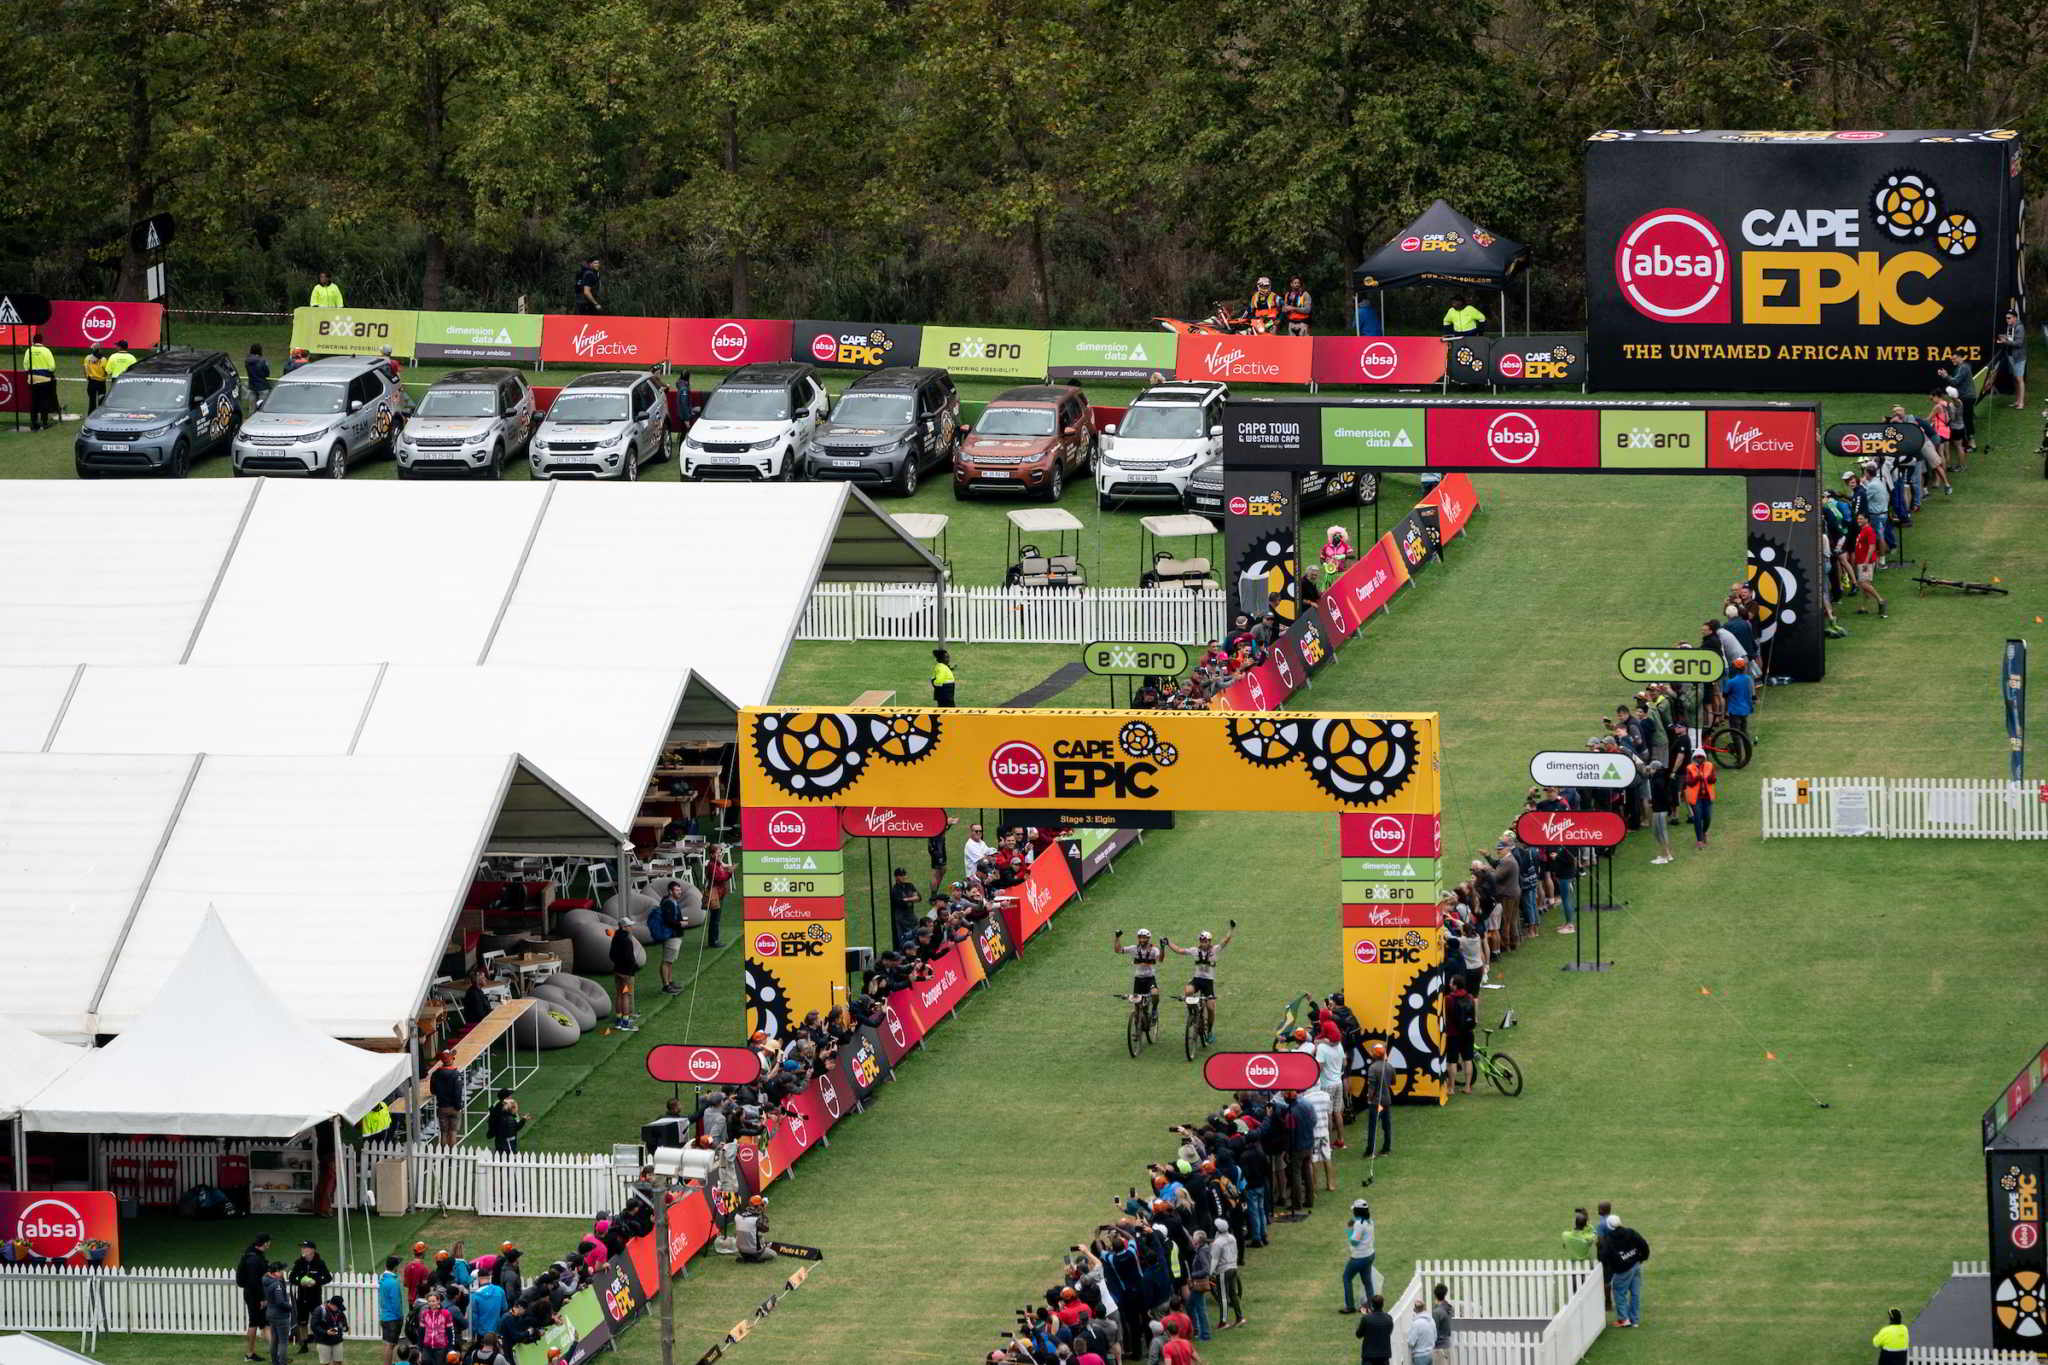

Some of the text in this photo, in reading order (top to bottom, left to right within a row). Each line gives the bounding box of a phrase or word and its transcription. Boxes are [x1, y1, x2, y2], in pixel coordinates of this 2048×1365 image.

[1741, 208, 1859, 248] CAPE
[1421, 240, 1457, 252] EPIC
[1634, 244, 1713, 278] absa
[1741, 250, 1944, 326] EPIC
[86, 318, 113, 329] absa
[319, 316, 389, 338] exxaro
[446, 326, 494, 336] dimension
[472, 335, 494, 344] data
[572, 323, 608, 358] Virgin
[715, 336, 743, 347] absa
[840, 334, 868, 346] CAPE
[596, 343, 637, 355] active
[949, 337, 1021, 359] exxaro
[1076, 342, 1128, 352] dimension
[1623, 344, 1982, 361] THE UNTAMED AFRICAN MTB RACE
[838, 345, 884, 365] EPIC
[1105, 351, 1128, 361] data
[1205, 342, 1245, 377] Virgin
[1365, 355, 1393, 366] absa
[1525, 352, 1550, 362] CAPE
[947, 365, 980, 373] POWERING
[1073, 369, 1103, 377] accelerate
[1233, 361, 1280, 376] active
[1524, 362, 1568, 378] EPIC
[1238, 422, 1300, 435] CAPE TOWN
[1334, 427, 1391, 438] dimension
[1245, 435, 1280, 443] WESTERN
[1493, 427, 1536, 444] absa
[1617, 428, 1690, 449] exxaro
[1726, 420, 1763, 453] Virgin
[1862, 432, 1883, 440] CAPE
[1366, 437, 1390, 448] data
[1751, 439, 1794, 452] active
[1862, 440, 1898, 454] EPIC
[1248, 495, 1269, 503] CAPE
[1772, 501, 1793, 510] CAPE
[1248, 502, 1282, 516] EPIC
[1772, 508, 1807, 523] EPIC
[1098, 646, 1175, 669] exxaro
[1633, 652, 1712, 676] exxaro
[1053, 739, 1113, 759] CAPE
[998, 759, 1040, 775] absa
[1546, 760, 1600, 771] dimension
[1054, 761, 1159, 799] EPIC
[1577, 770, 1600, 780] data
[865, 806, 896, 833] Virgin
[888, 818, 924, 831] active
[1060, 815, 1116, 825] Stage 3: Elgin
[773, 821, 801, 833] absa
[1374, 825, 1401, 840] absa
[1542, 812, 1575, 842] Virgin
[1565, 828, 1603, 840] active
[761, 855, 801, 863] dimension
[763, 878, 814, 893] exxaro
[1365, 885, 1414, 899] exxaro
[768, 898, 791, 918] Virgin
[784, 910, 811, 918] active
[1369, 905, 1391, 926] Virgin
[1384, 917, 1410, 925] active
[781, 932, 806, 941] CAPE
[1380, 939, 1404, 947] CAPE
[781, 941, 823, 957] EPIC
[1380, 948, 1420, 964] EPIC
[692, 1059, 717, 1070] absa
[1250, 1063, 1275, 1076] absa
[2019, 1174, 2038, 1221] EPIC
[2009, 1191, 2020, 1221] CAPE
[25, 1217, 77, 1239] absa
